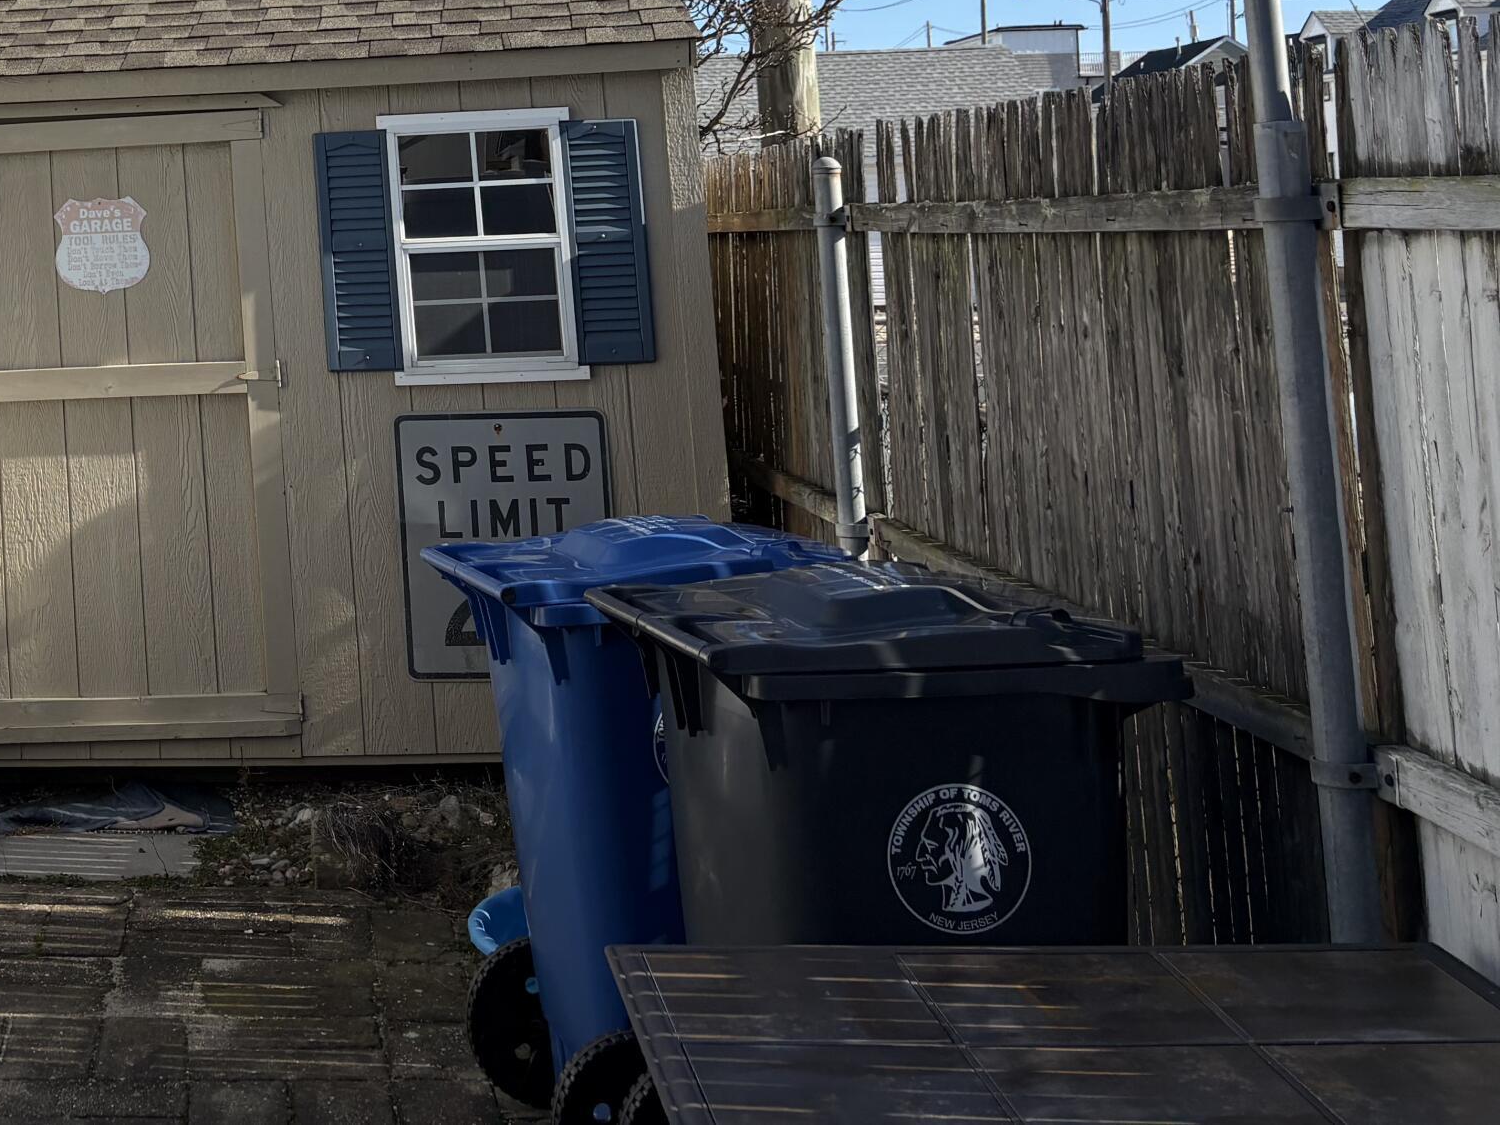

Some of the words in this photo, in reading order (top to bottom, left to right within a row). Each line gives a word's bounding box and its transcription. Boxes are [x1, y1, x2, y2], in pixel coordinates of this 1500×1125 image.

[79, 207, 121, 219] Dave's
[70, 218, 132, 233] GARAGE
[67, 235, 97, 247] TOOL
[415, 443, 591, 486] SPEED
[437, 497, 571, 539] LIMIT
[891, 792, 937, 856] TOWNSHIP
[939, 787, 958, 800] OF
[961, 787, 1001, 813] TOMS
[998, 808, 1027, 853] RIVER
[896, 861, 917, 880] 1767
[928, 912, 956, 930] NEW
[957, 911, 1000, 931] JERSEY
